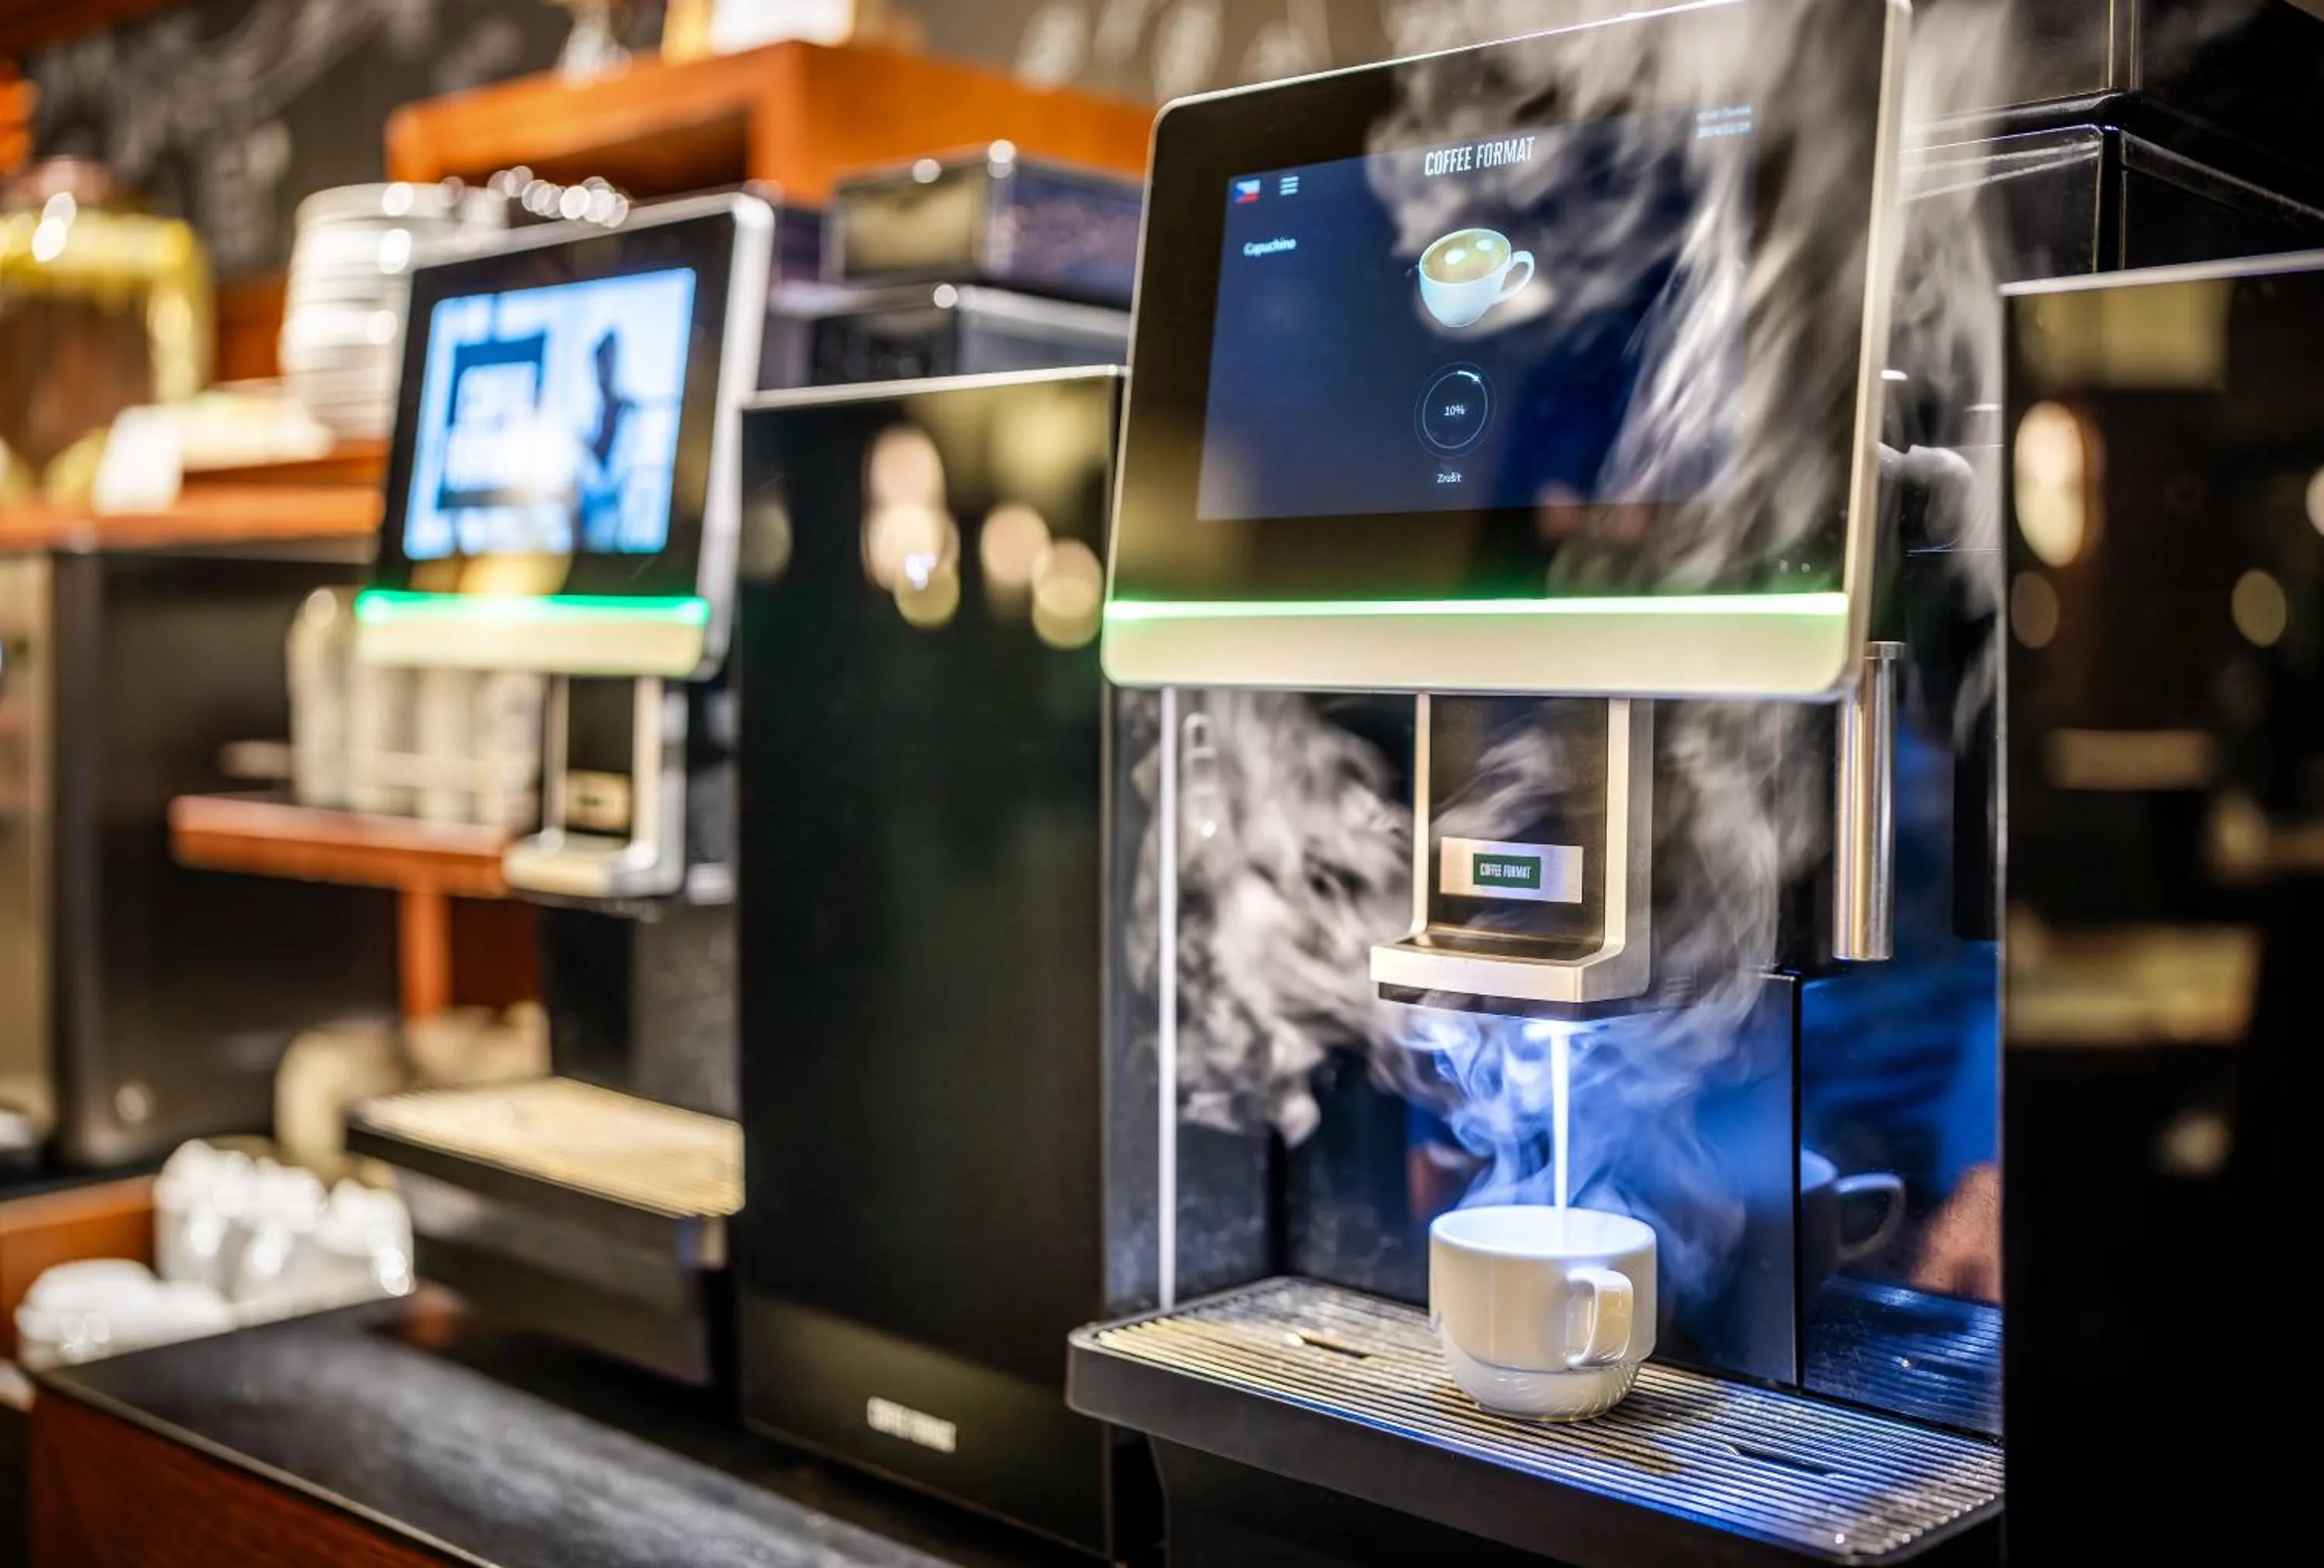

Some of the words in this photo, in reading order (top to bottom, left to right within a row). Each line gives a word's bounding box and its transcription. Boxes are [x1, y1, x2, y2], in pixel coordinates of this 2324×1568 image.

[1425, 146, 1472, 176] COFFEE
[1476, 136, 1535, 169] FORMAT
[1444, 405, 1465, 416] 10%
[1480, 863, 1502, 878] COFFEE
[1504, 865, 1531, 879] FORMAT
